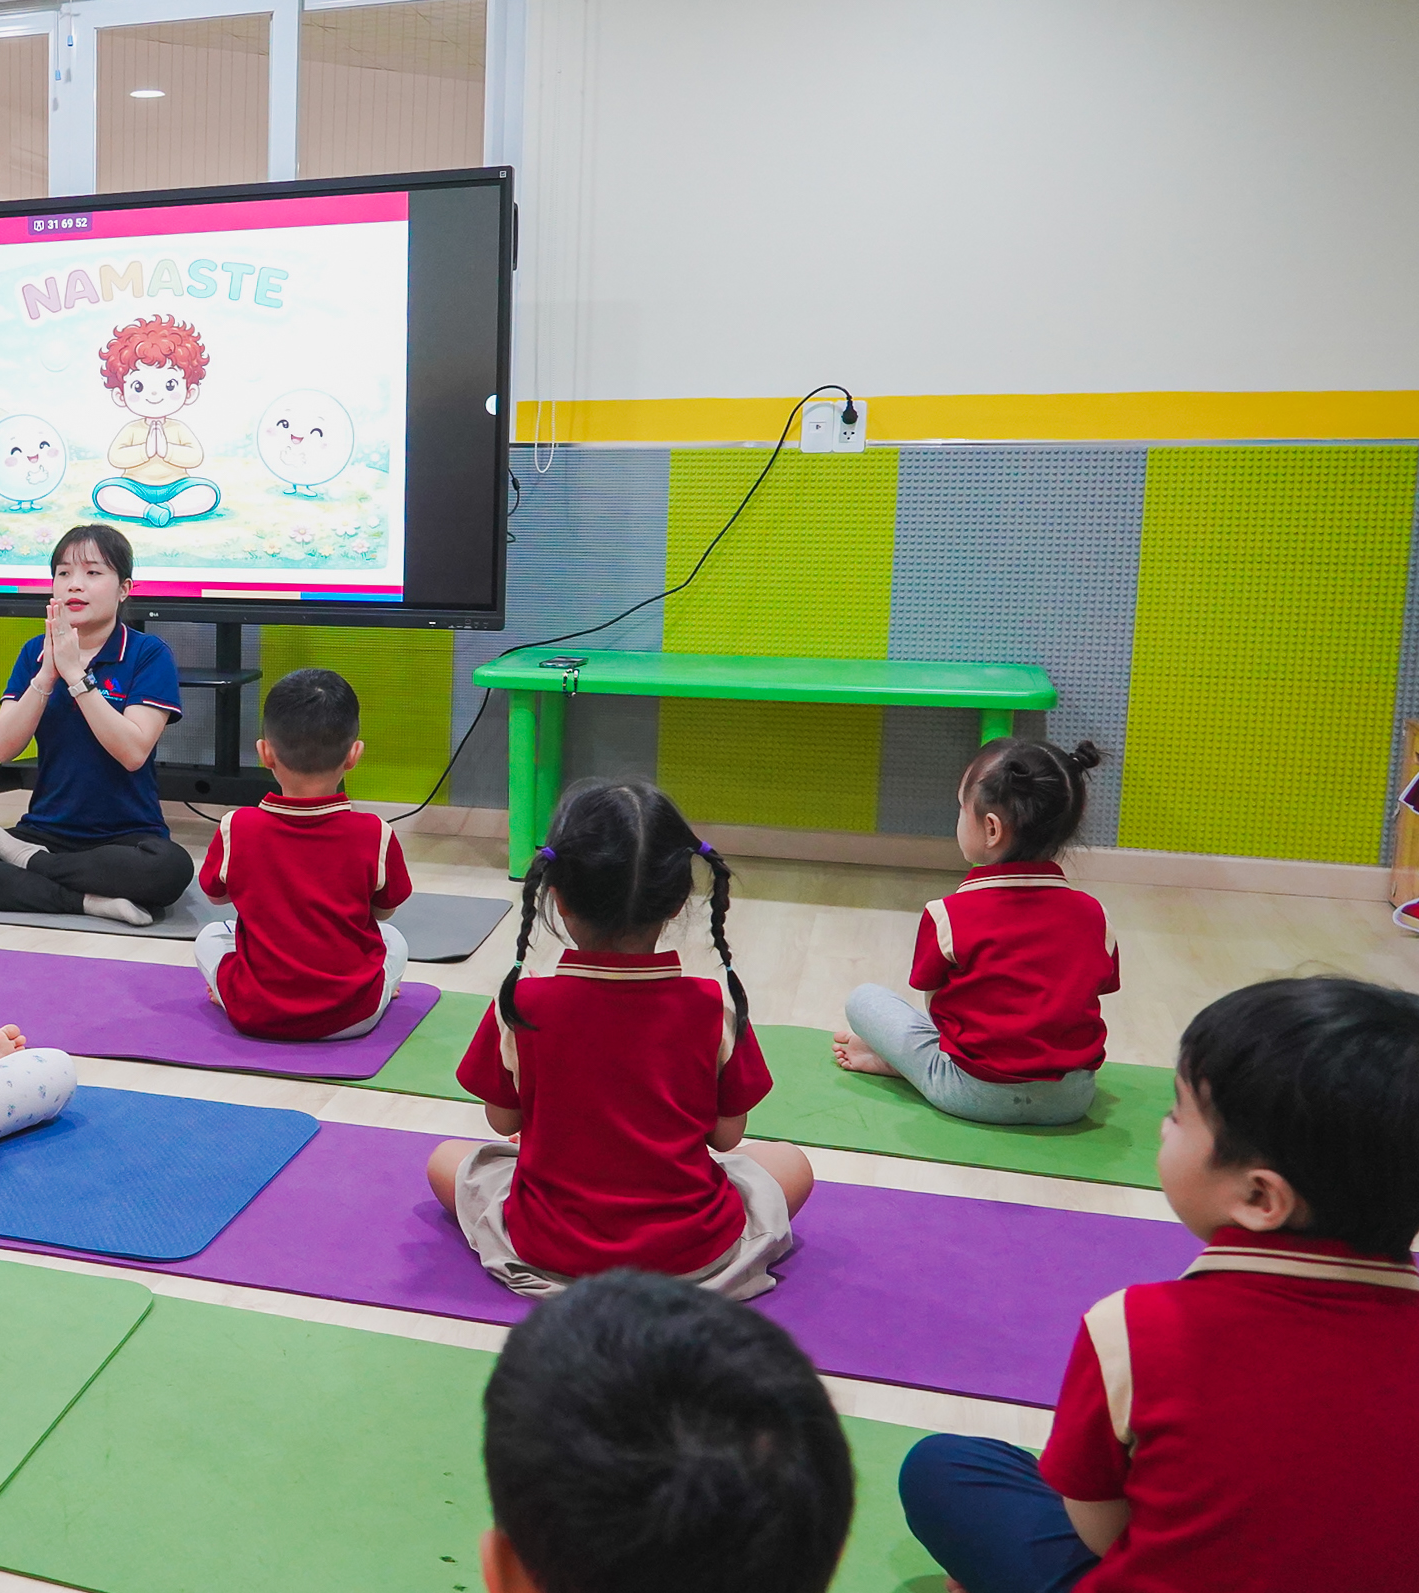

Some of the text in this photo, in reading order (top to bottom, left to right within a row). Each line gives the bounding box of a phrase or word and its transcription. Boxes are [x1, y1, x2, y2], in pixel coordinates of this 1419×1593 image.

[47, 217, 88, 229] 31 69 52
[21, 258, 289, 320] NAMASTE
